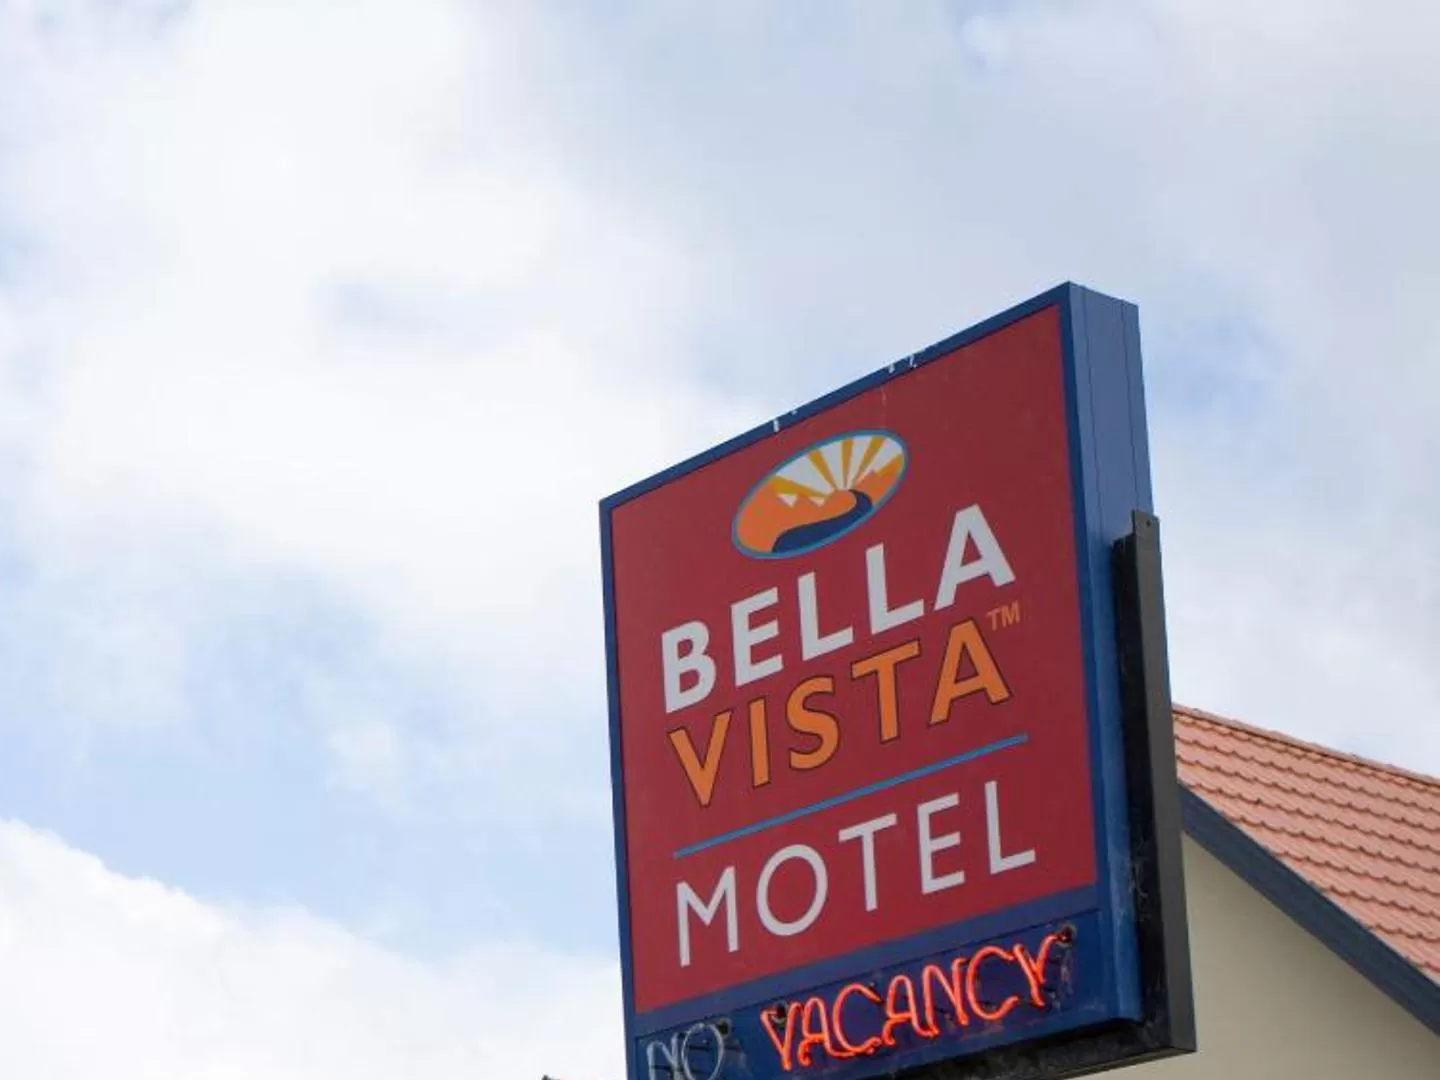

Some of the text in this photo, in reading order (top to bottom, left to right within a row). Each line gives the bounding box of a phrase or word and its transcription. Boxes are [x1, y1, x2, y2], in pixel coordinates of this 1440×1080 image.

[661, 503, 1016, 713] BELLA
[667, 617, 1014, 808] VISTA
[676, 780, 1036, 967] MOTEL
[761, 932, 1063, 1071] VACANCY
